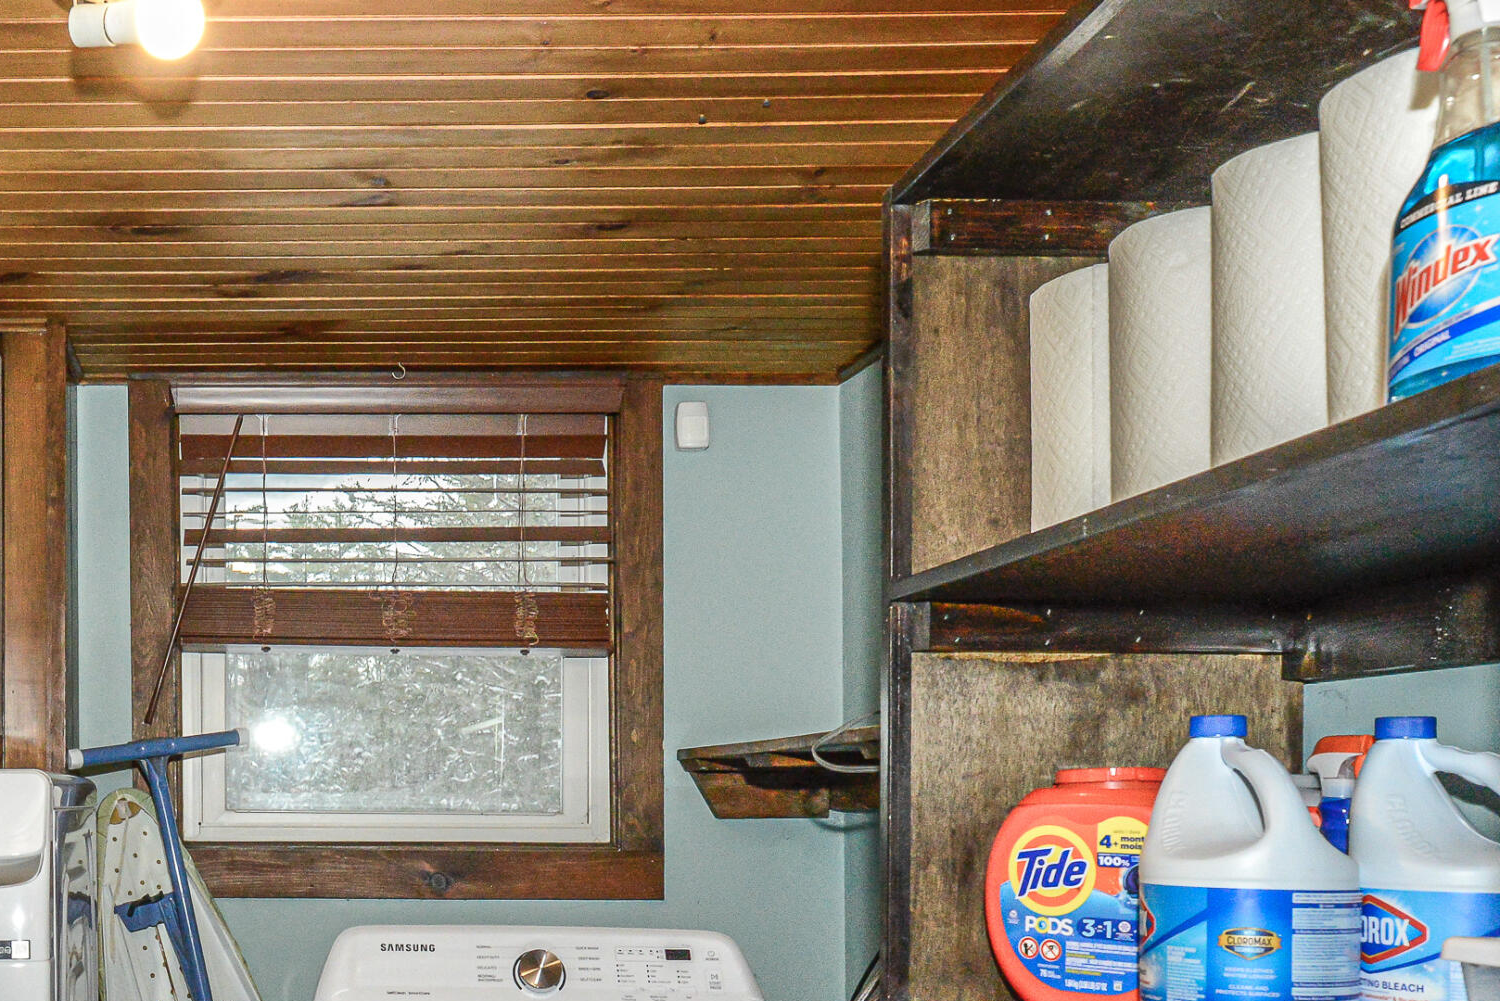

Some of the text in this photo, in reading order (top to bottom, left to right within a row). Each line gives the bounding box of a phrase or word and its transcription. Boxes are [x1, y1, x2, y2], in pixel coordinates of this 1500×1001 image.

[1393, 238, 1492, 337] Windex
[1098, 855, 1130, 867] 100%
[1016, 847, 1088, 898] Tide
[1025, 915, 1074, 936] PODS
[1361, 915, 1410, 947] ROX
[380, 943, 436, 953] SAMSUNG
[1381, 980, 1425, 993] BLEACH
